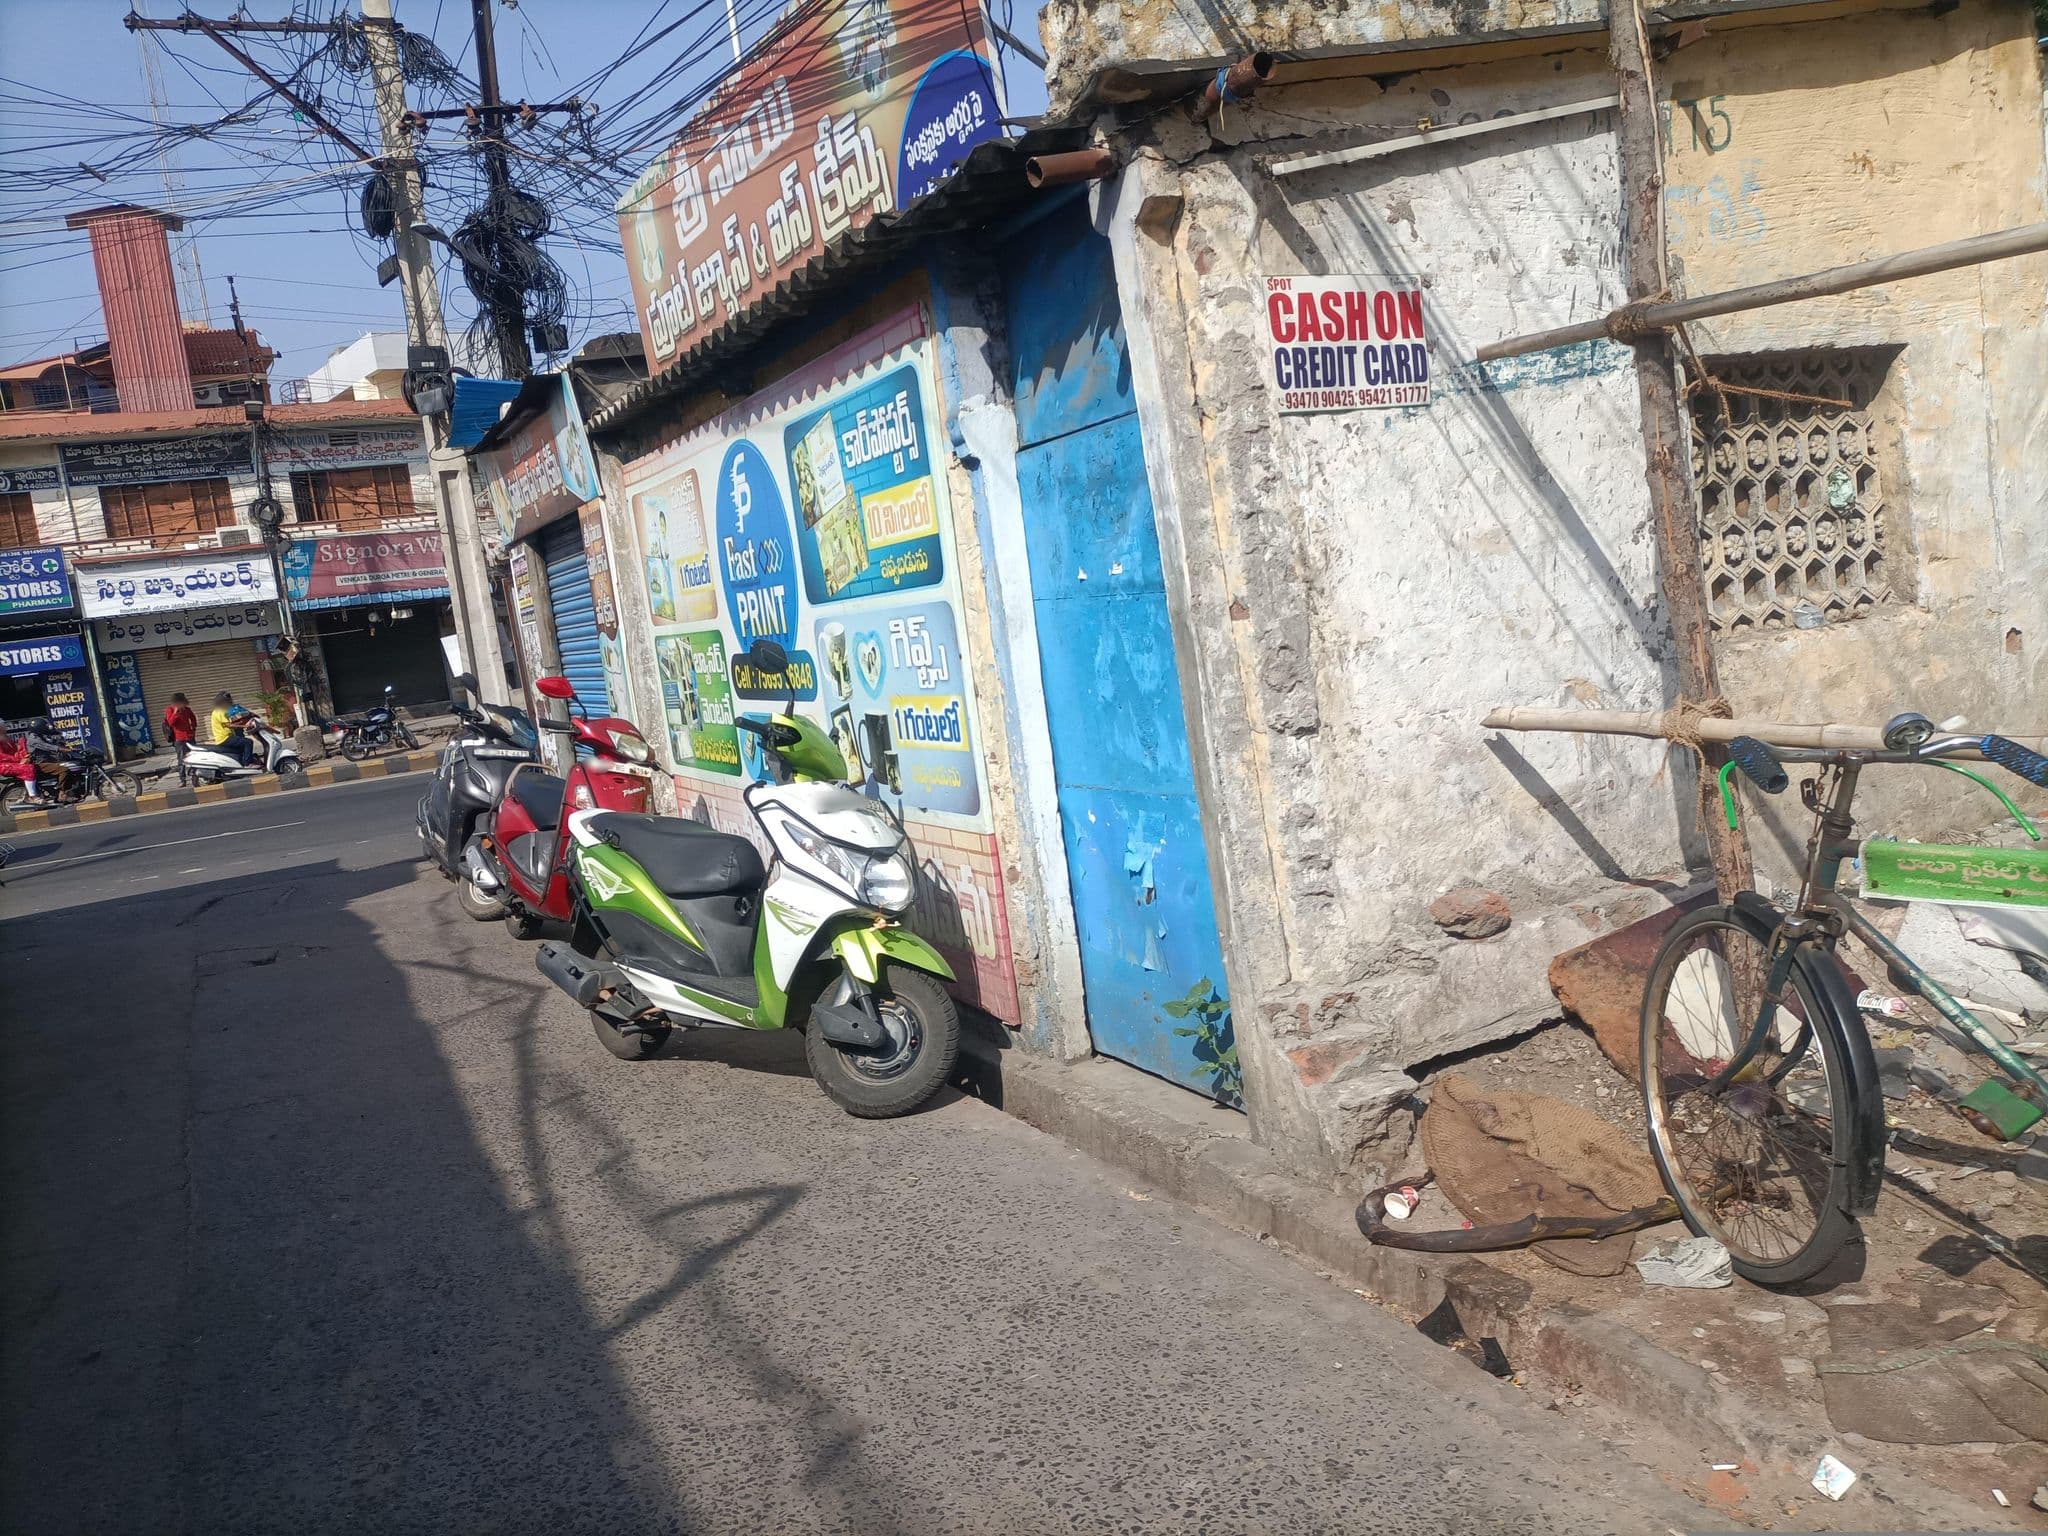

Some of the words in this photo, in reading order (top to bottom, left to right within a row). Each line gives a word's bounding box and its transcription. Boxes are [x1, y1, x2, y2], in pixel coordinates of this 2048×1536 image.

[704, 75, 794, 206] సాయి
[750, 222, 770, 277] &
[1267, 278, 1292, 291] SPOT
[1267, 291, 1369, 343] CASH
[1373, 290, 1425, 342] ON
[1274, 345, 1357, 390] CREDIT
[1363, 343, 1429, 386] CARD
[1285, 391, 1320, 409] 93470
[1359, 388, 1393, 405] 95421
[1395, 386, 1429, 403] 51777
[361, 430, 417, 442] STUDIO
[724, 536, 759, 582] Fast
[0, 580, 62, 600] STORES
[12, 597, 64, 609] PHARMACY
[736, 585, 787, 638] PRINT
[0, 645, 62, 667] STORES
[46, 681, 73, 693] HIV
[47, 691, 85, 705] CANCER
[50, 704, 84, 718] KIDNEY
[894, 708, 903, 740] 1
